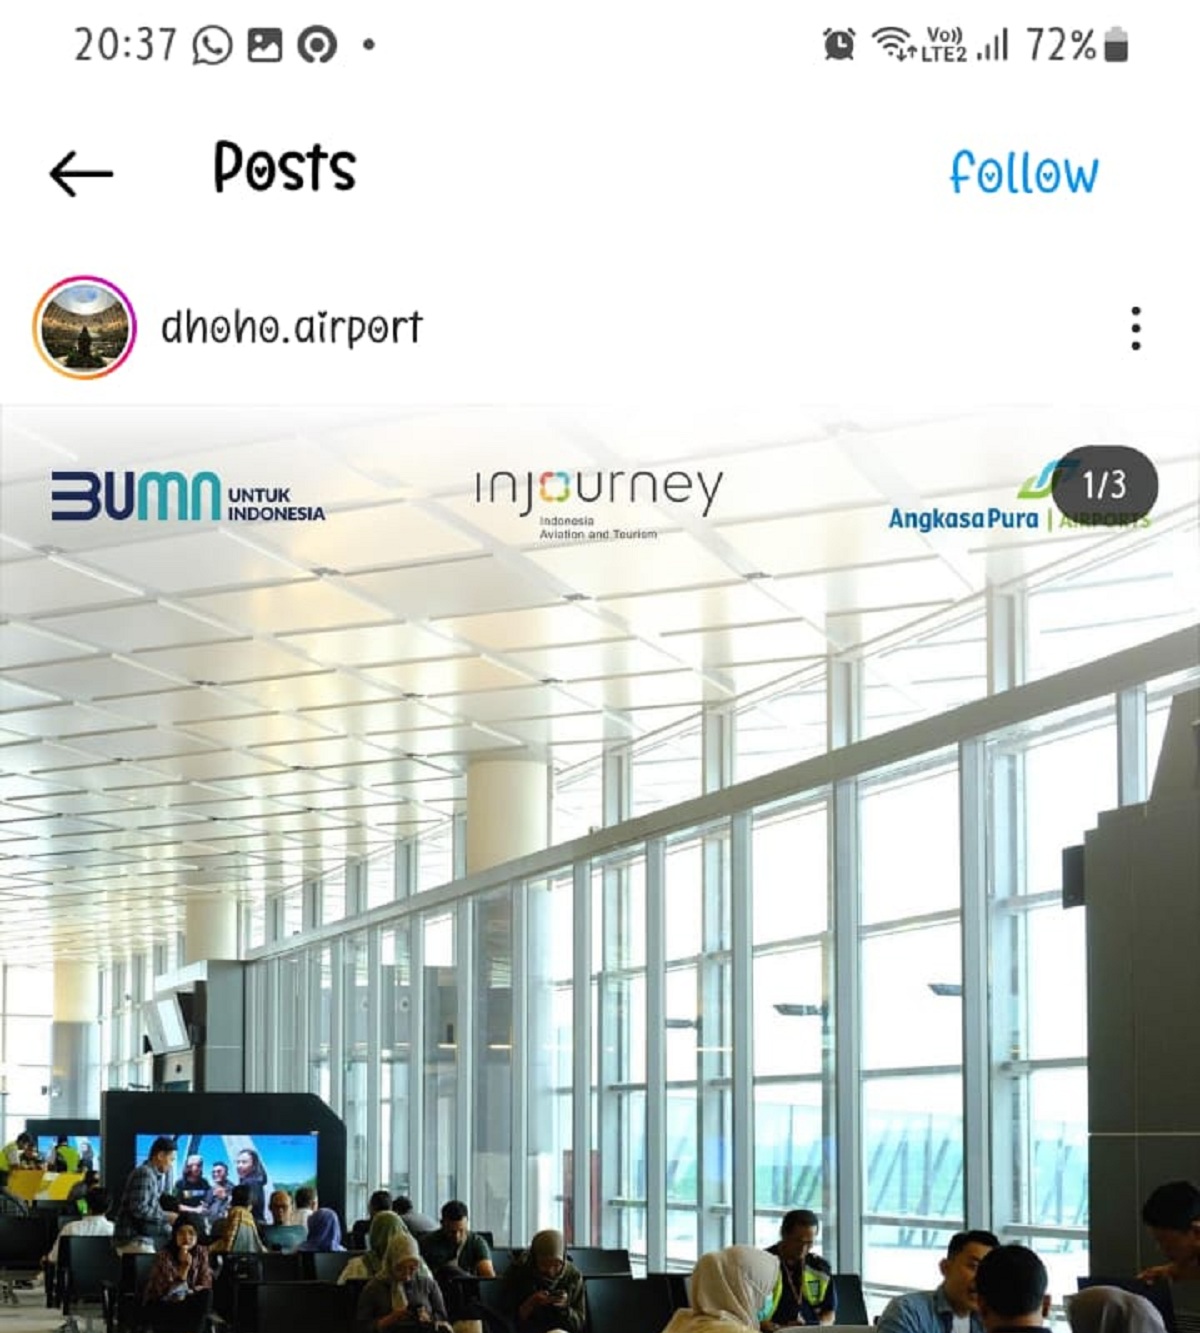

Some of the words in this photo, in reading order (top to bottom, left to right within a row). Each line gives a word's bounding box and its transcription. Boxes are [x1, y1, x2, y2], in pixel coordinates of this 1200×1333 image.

[75, 27, 177, 61] 20:37
[921, 46, 968, 63] LTE2
[1027, 27, 1097, 60] 72%
[214, 140, 358, 194] Posts
[162, 308, 424, 350] dhoho.airport
